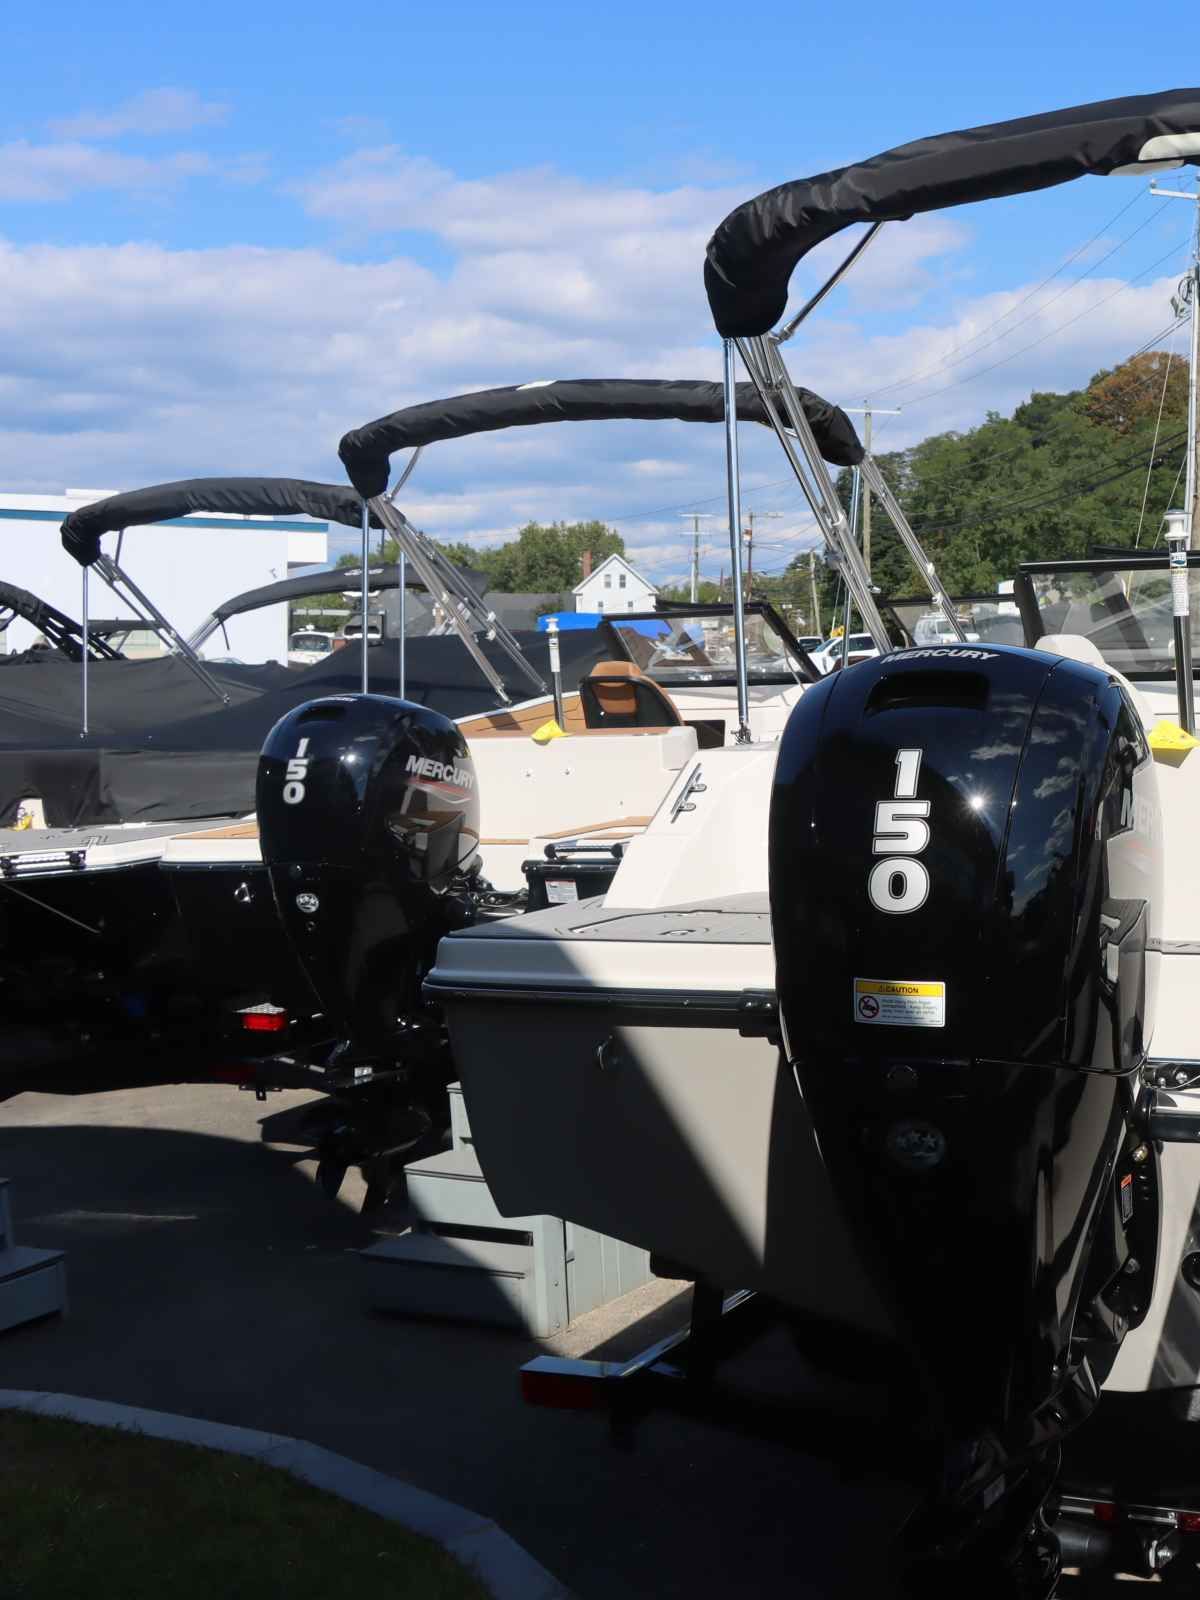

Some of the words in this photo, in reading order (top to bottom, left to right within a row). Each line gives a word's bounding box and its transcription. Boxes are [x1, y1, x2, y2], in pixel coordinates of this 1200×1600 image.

[880, 648, 1000, 664] MERCURY
[283, 738, 309, 805] 150
[406, 755, 473, 790] MERCURY
[868, 749, 931, 914] 150
[885, 986, 919, 994] CAUTION
